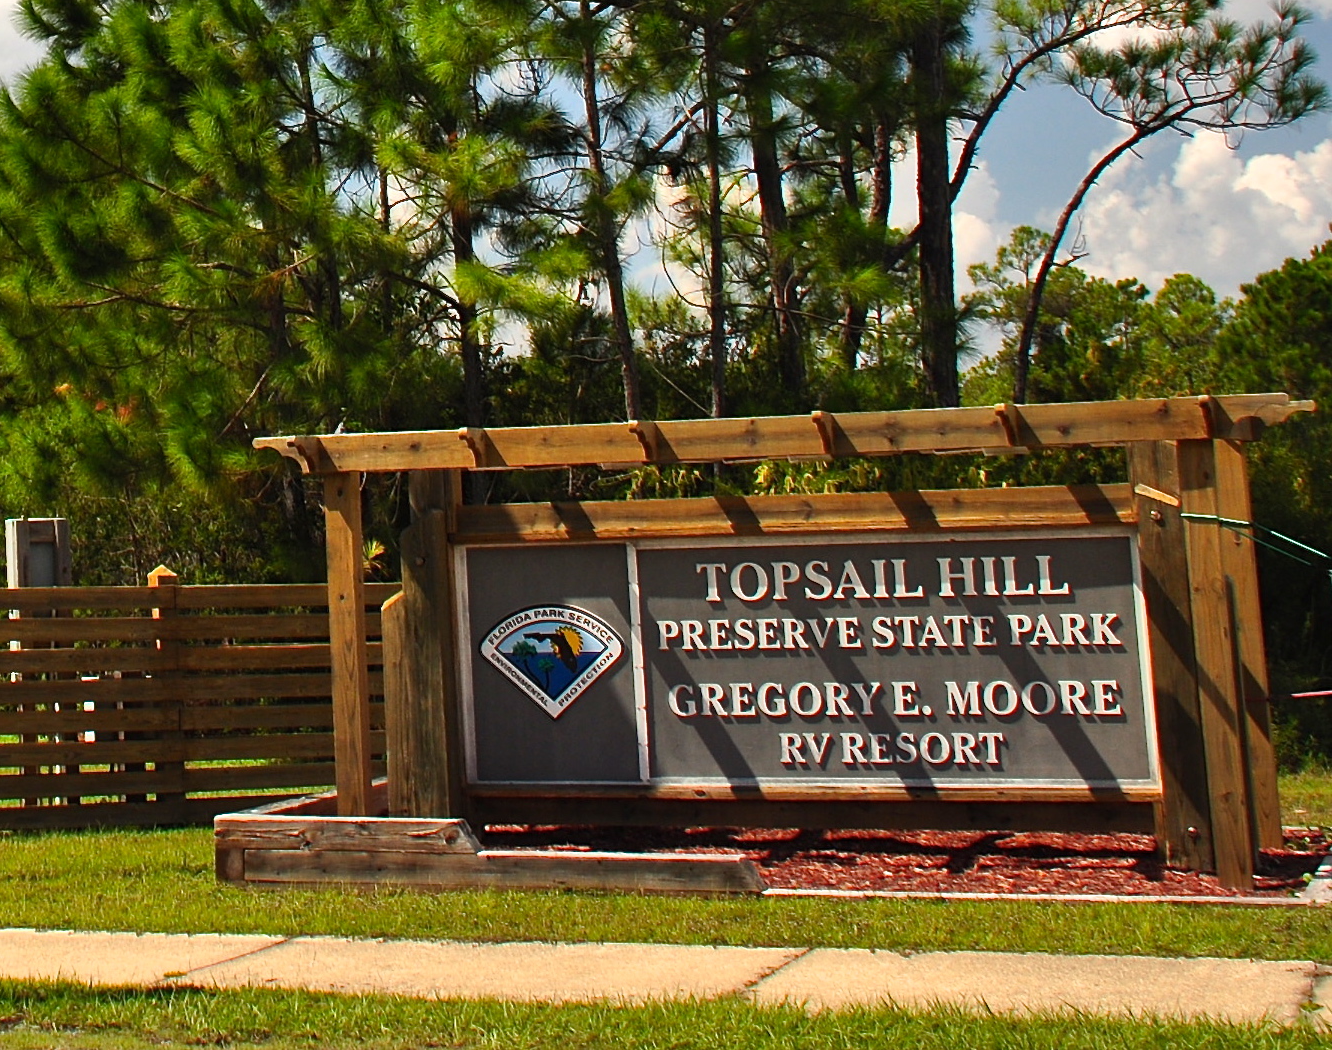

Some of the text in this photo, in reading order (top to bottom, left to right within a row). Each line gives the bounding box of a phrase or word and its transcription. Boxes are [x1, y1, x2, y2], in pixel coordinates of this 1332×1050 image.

[695, 555, 1070, 602] TOPSAIL HILL
[488, 609, 613, 645] FLORIDA PARK SERVICE
[656, 612, 1123, 650] PRESERVE STATE PARK
[490, 653, 548, 706] ENVIRONMENTAL
[558, 653, 613, 706] PROTECTION
[668, 679, 1122, 718] GREGORY E. MOORE
[779, 731, 1003, 764] RV RESORT
